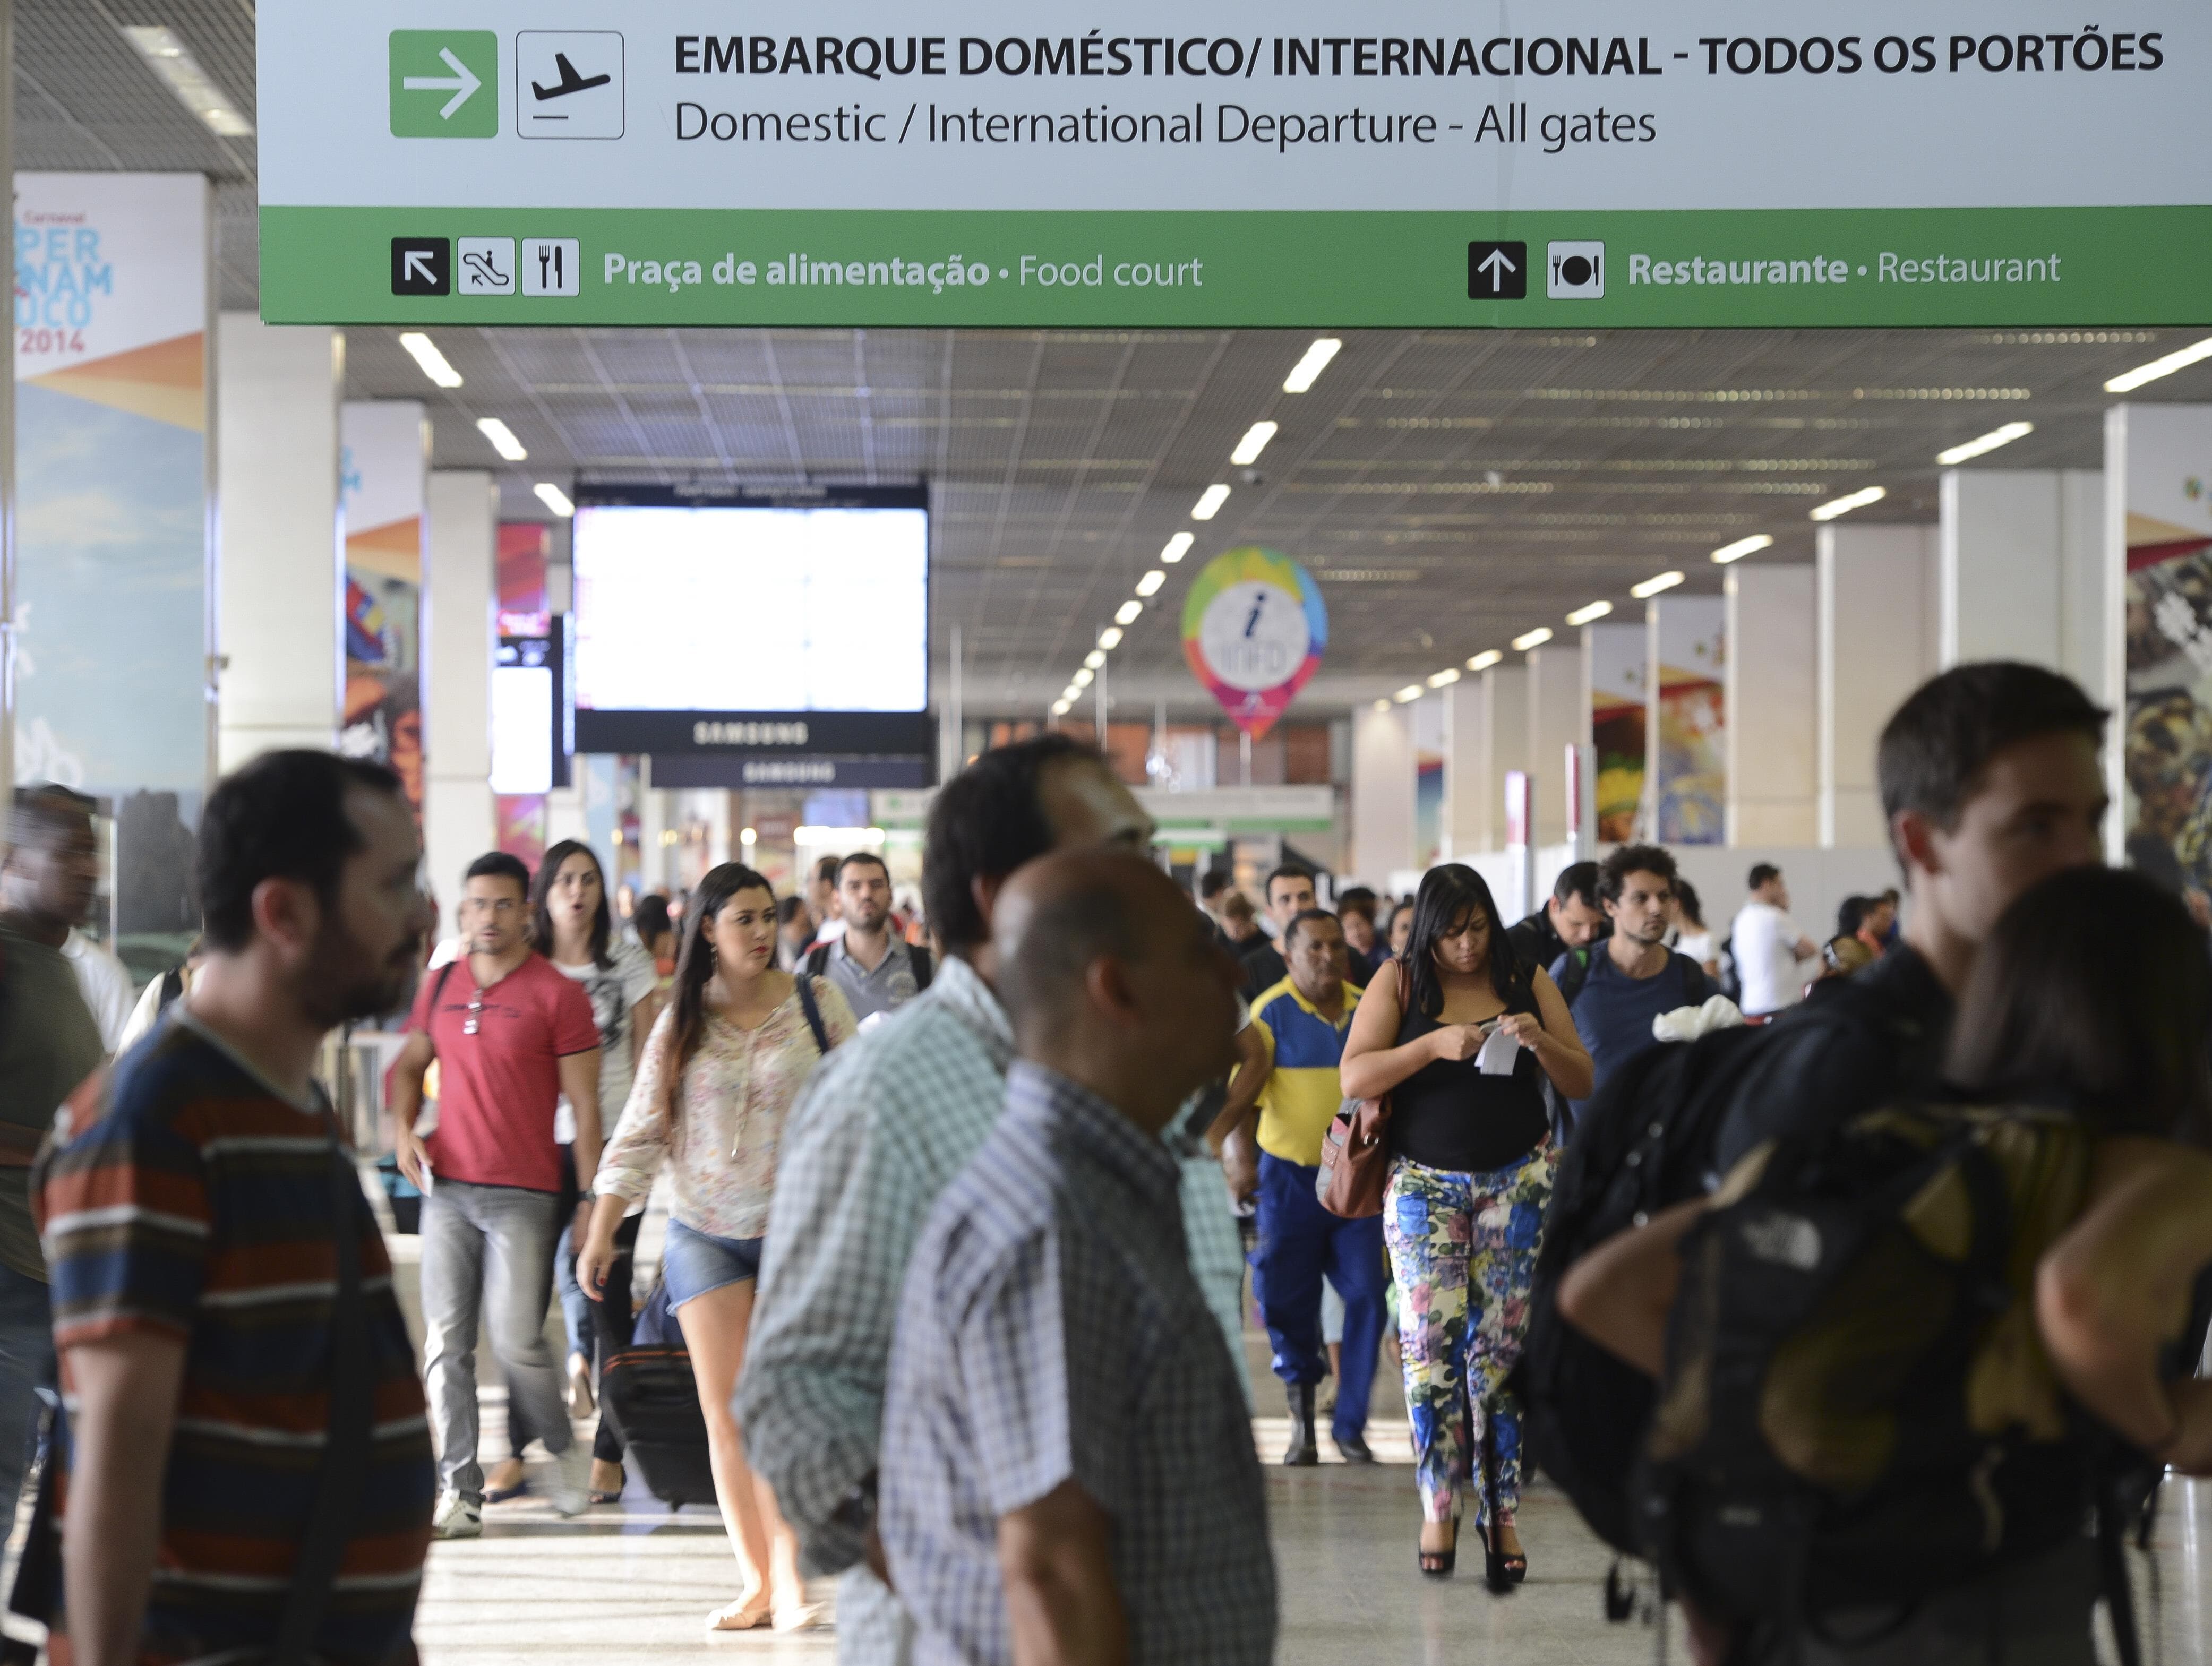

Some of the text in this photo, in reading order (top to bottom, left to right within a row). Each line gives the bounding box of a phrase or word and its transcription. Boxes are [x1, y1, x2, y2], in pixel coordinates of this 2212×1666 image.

[675, 36, 946, 81] EMBARQUE
[1274, 37, 1662, 76] INTERNACIONAL
[1699, 36, 1862, 75] TODOS
[1874, 36, 1936, 74] OS
[1949, 24, 2164, 73] PORTÕES
[676, 102, 886, 142] Domestic
[930, 103, 1202, 143] International
[1218, 105, 1437, 153] Departure
[1474, 102, 1527, 143] All
[1540, 107, 1656, 153] gates
[15, 227, 99, 262] PER
[604, 253, 701, 293] Praça
[712, 252, 757, 285] de
[766, 253, 990, 294] alimentação
[1020, 255, 1102, 287] Food
[1113, 258, 1203, 287] court
[1629, 254, 1848, 285] Restaurante
[1879, 252, 2061, 283] Restaurant
[21, 329, 85, 354] 2014
[693, 722, 808, 745] SAMSUNG
